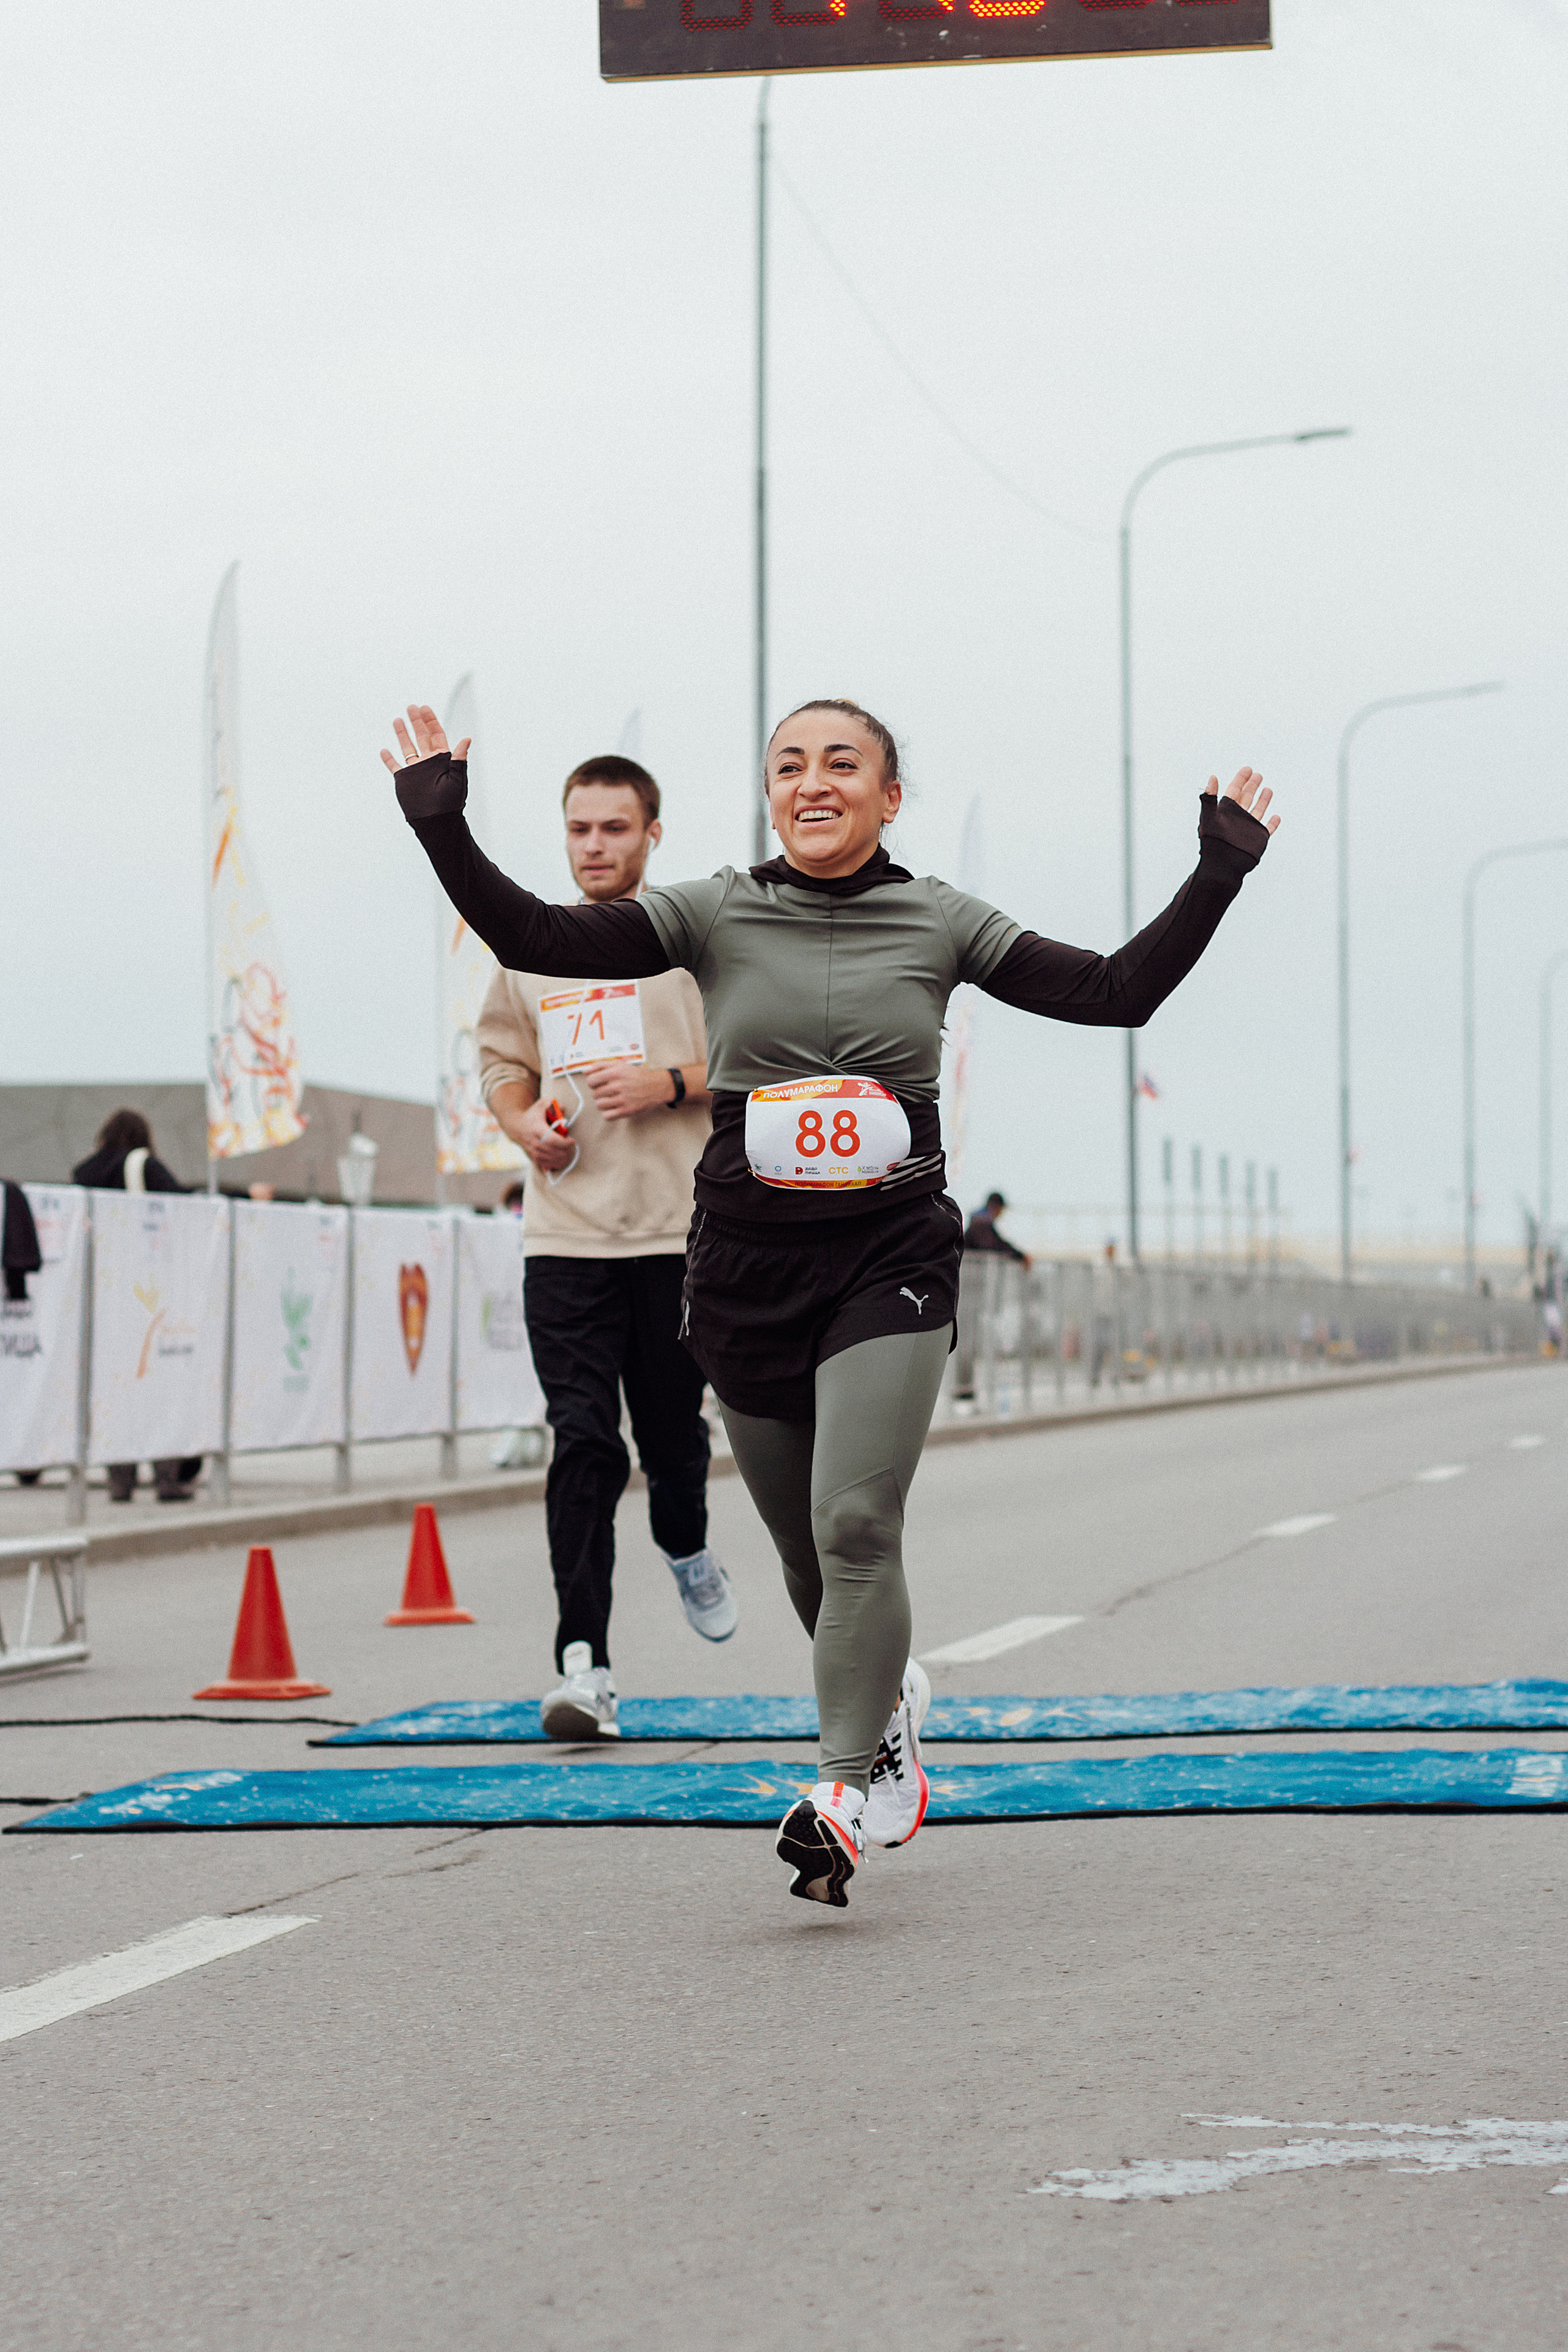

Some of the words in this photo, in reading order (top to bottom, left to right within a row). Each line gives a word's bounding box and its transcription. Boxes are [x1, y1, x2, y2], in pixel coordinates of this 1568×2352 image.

[567, 1009, 605, 1046] 71
[763, 1084, 839, 1098] ПОЛУМАРАФОН
[796, 1109, 861, 1158] 88
